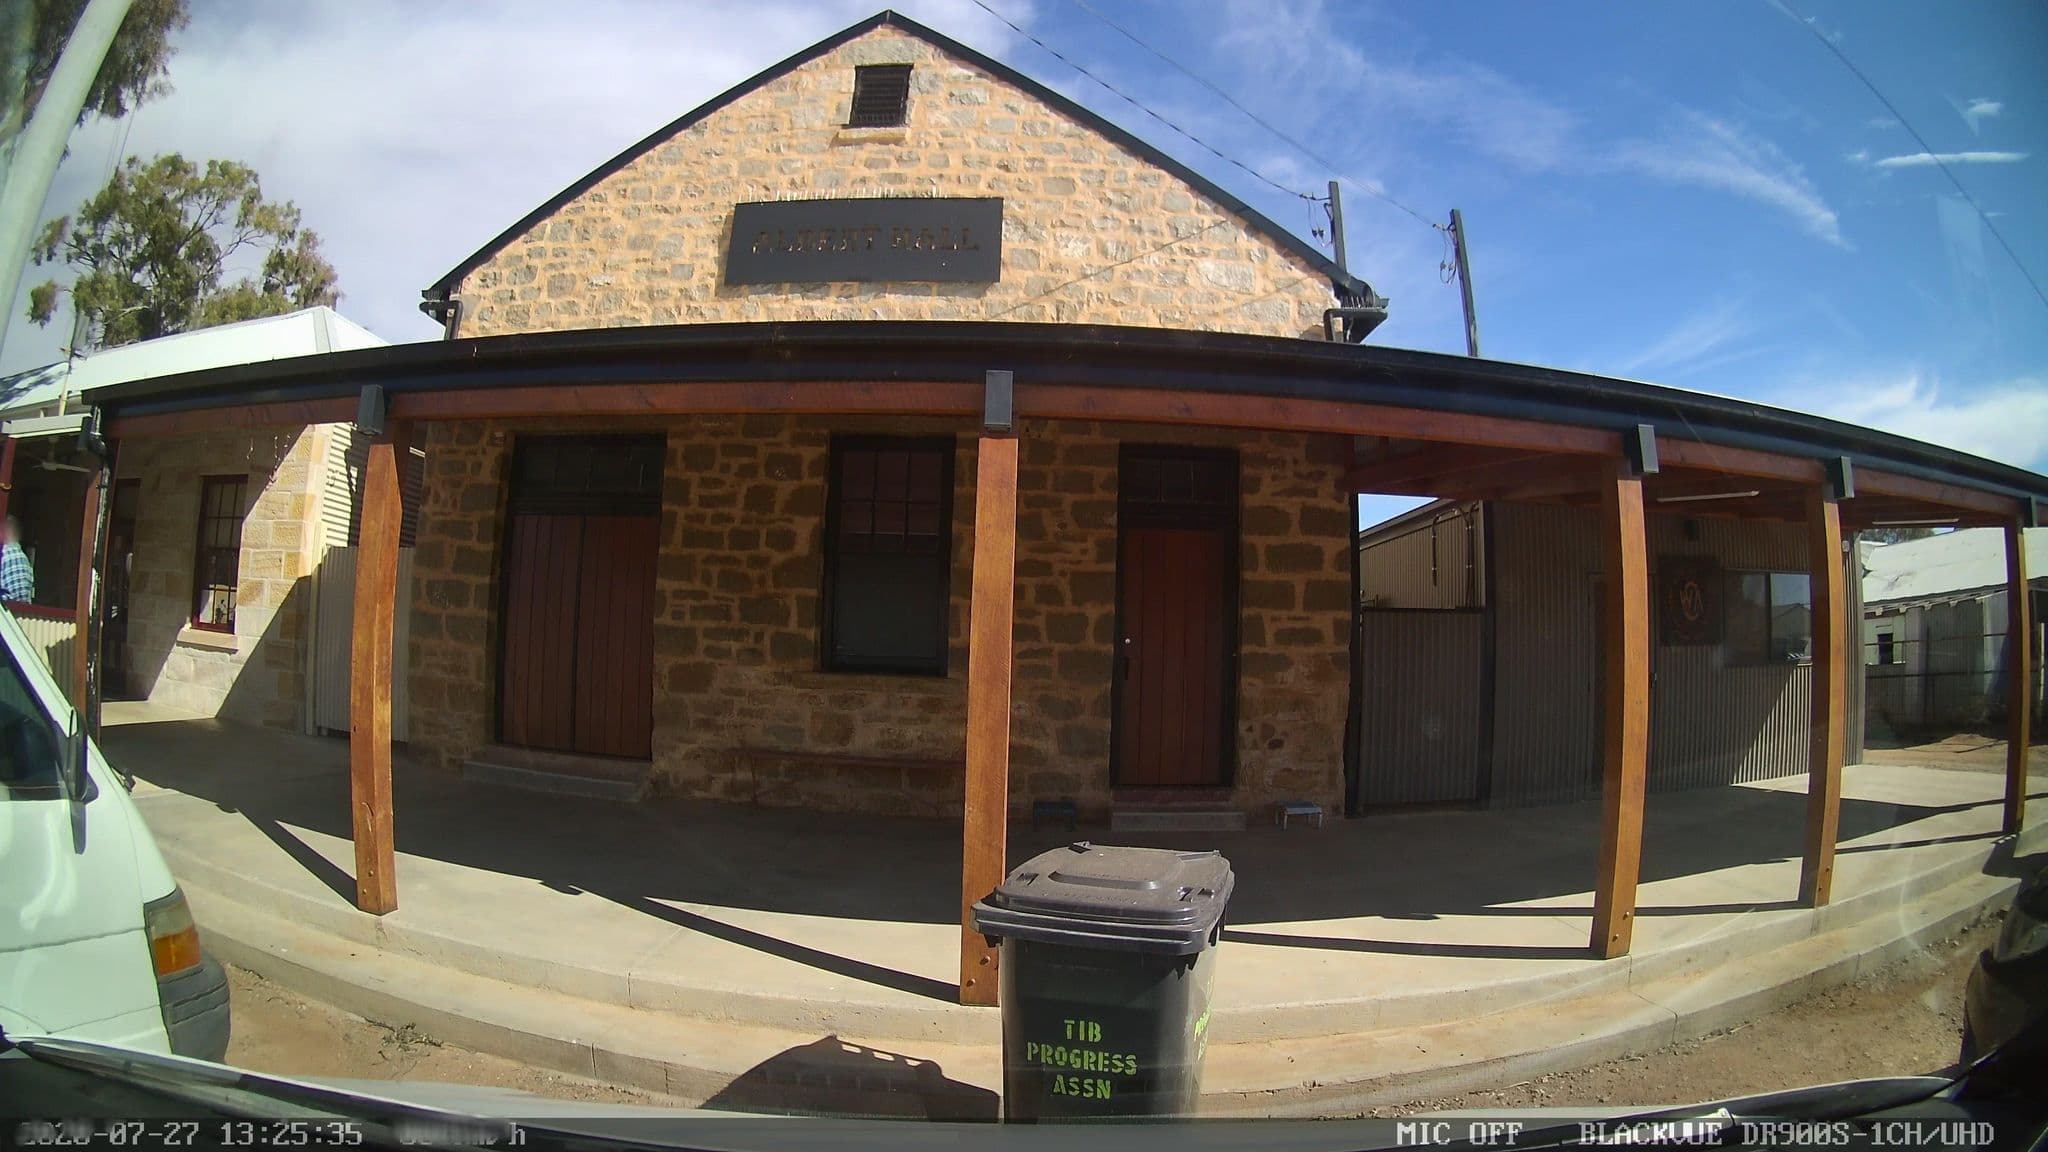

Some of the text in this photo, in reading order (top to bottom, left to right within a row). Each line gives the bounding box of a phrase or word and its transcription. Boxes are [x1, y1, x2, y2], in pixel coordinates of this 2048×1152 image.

[1063, 1019, 1103, 1043] TIB
[1026, 1041, 1138, 1075] PROGRESS
[1052, 1074, 1111, 1100] ASSN
